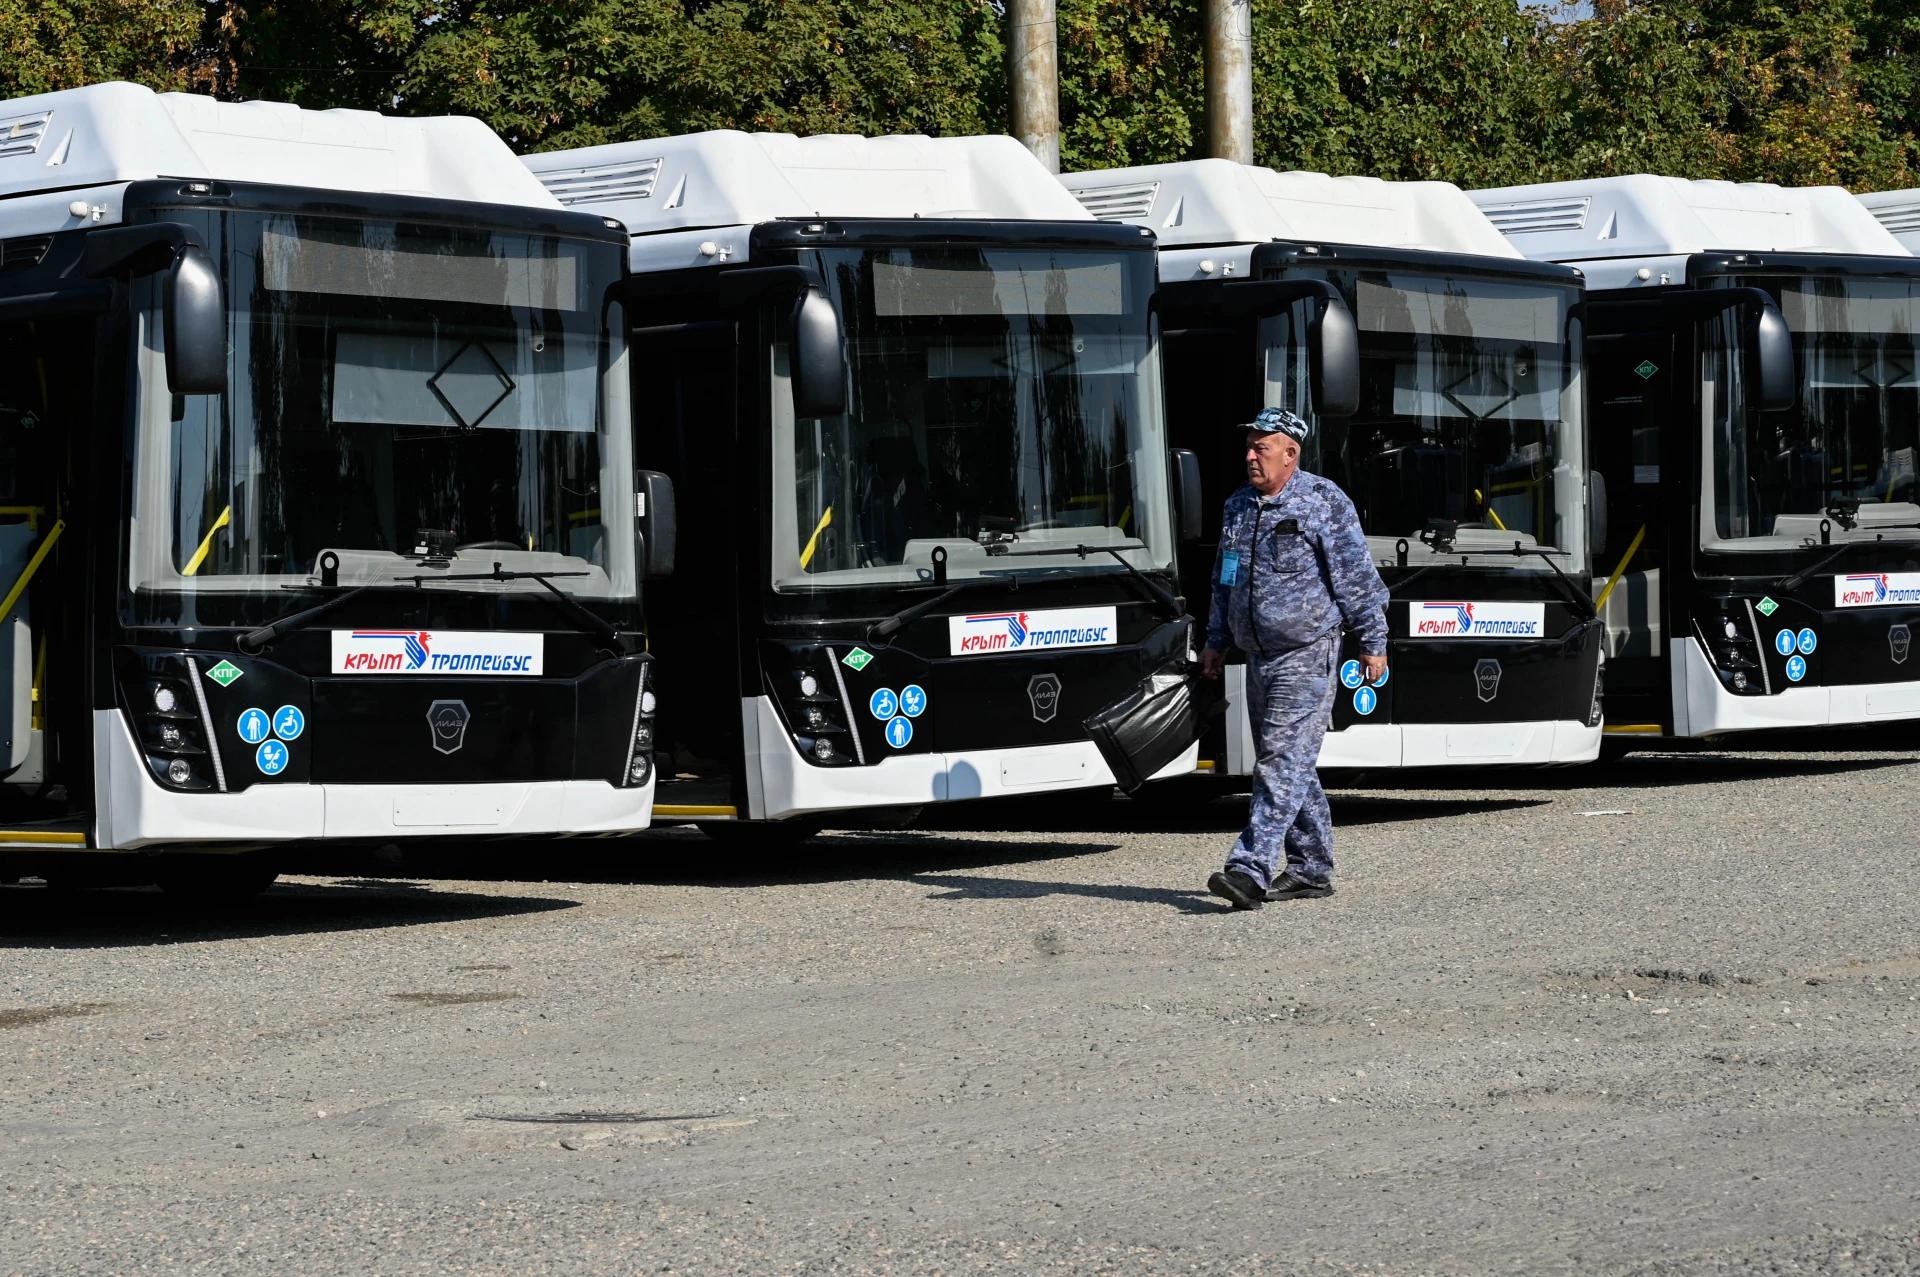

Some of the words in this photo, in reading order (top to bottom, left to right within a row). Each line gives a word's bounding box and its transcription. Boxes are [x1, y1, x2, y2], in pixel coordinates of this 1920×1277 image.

[1842, 591, 1874, 604] КРЫМ
[1418, 620, 1456, 634] КРЫМ
[1473, 620, 1537, 634] ТРОЛЛЕЙБУС
[961, 634, 1007, 651] КРЫМ
[1030, 627, 1108, 646] ТРОЛЛЕЙБУС
[344, 653, 403, 670] КРЫМ
[431, 654, 532, 672] ТРОЛЛЕЙБУС
[213, 668, 235, 678] КПГ
